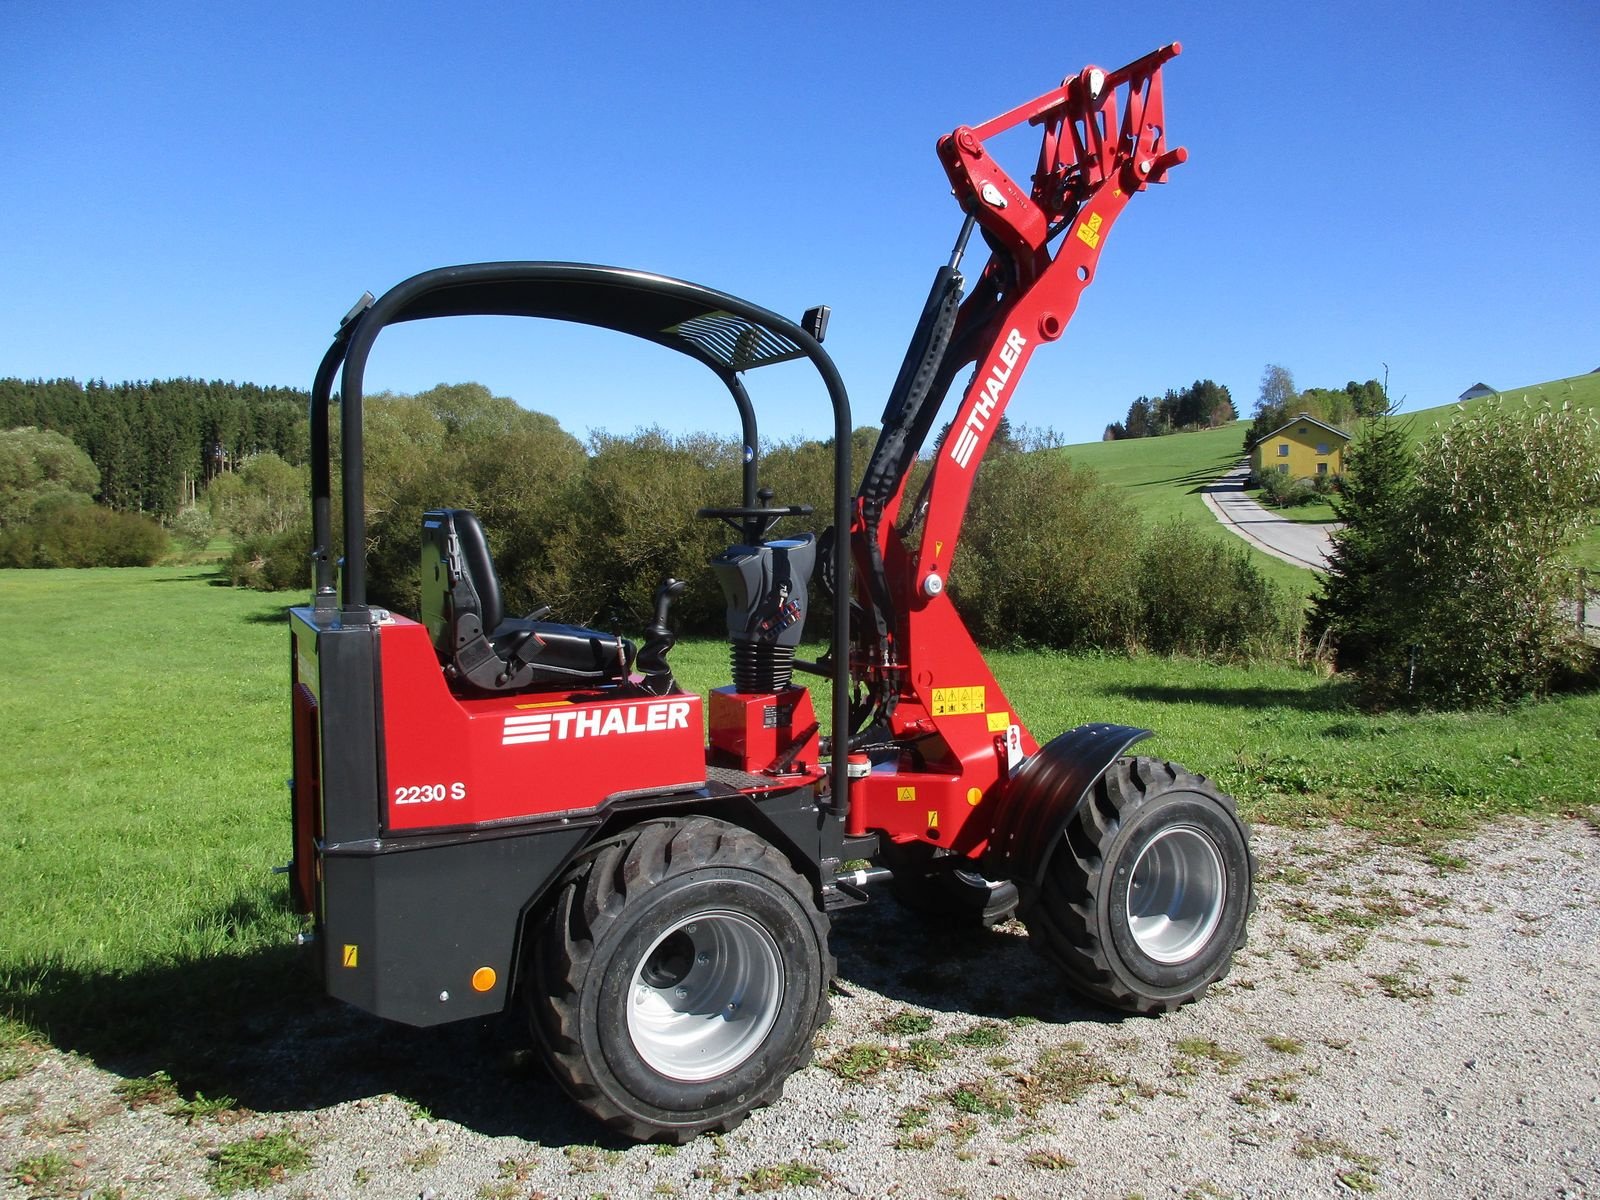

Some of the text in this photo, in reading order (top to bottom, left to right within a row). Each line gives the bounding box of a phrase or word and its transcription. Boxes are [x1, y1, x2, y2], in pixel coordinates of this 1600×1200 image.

[966, 328, 1027, 432] THALER
[552, 703, 691, 740] THALER
[395, 782, 466, 805] 2230 S
